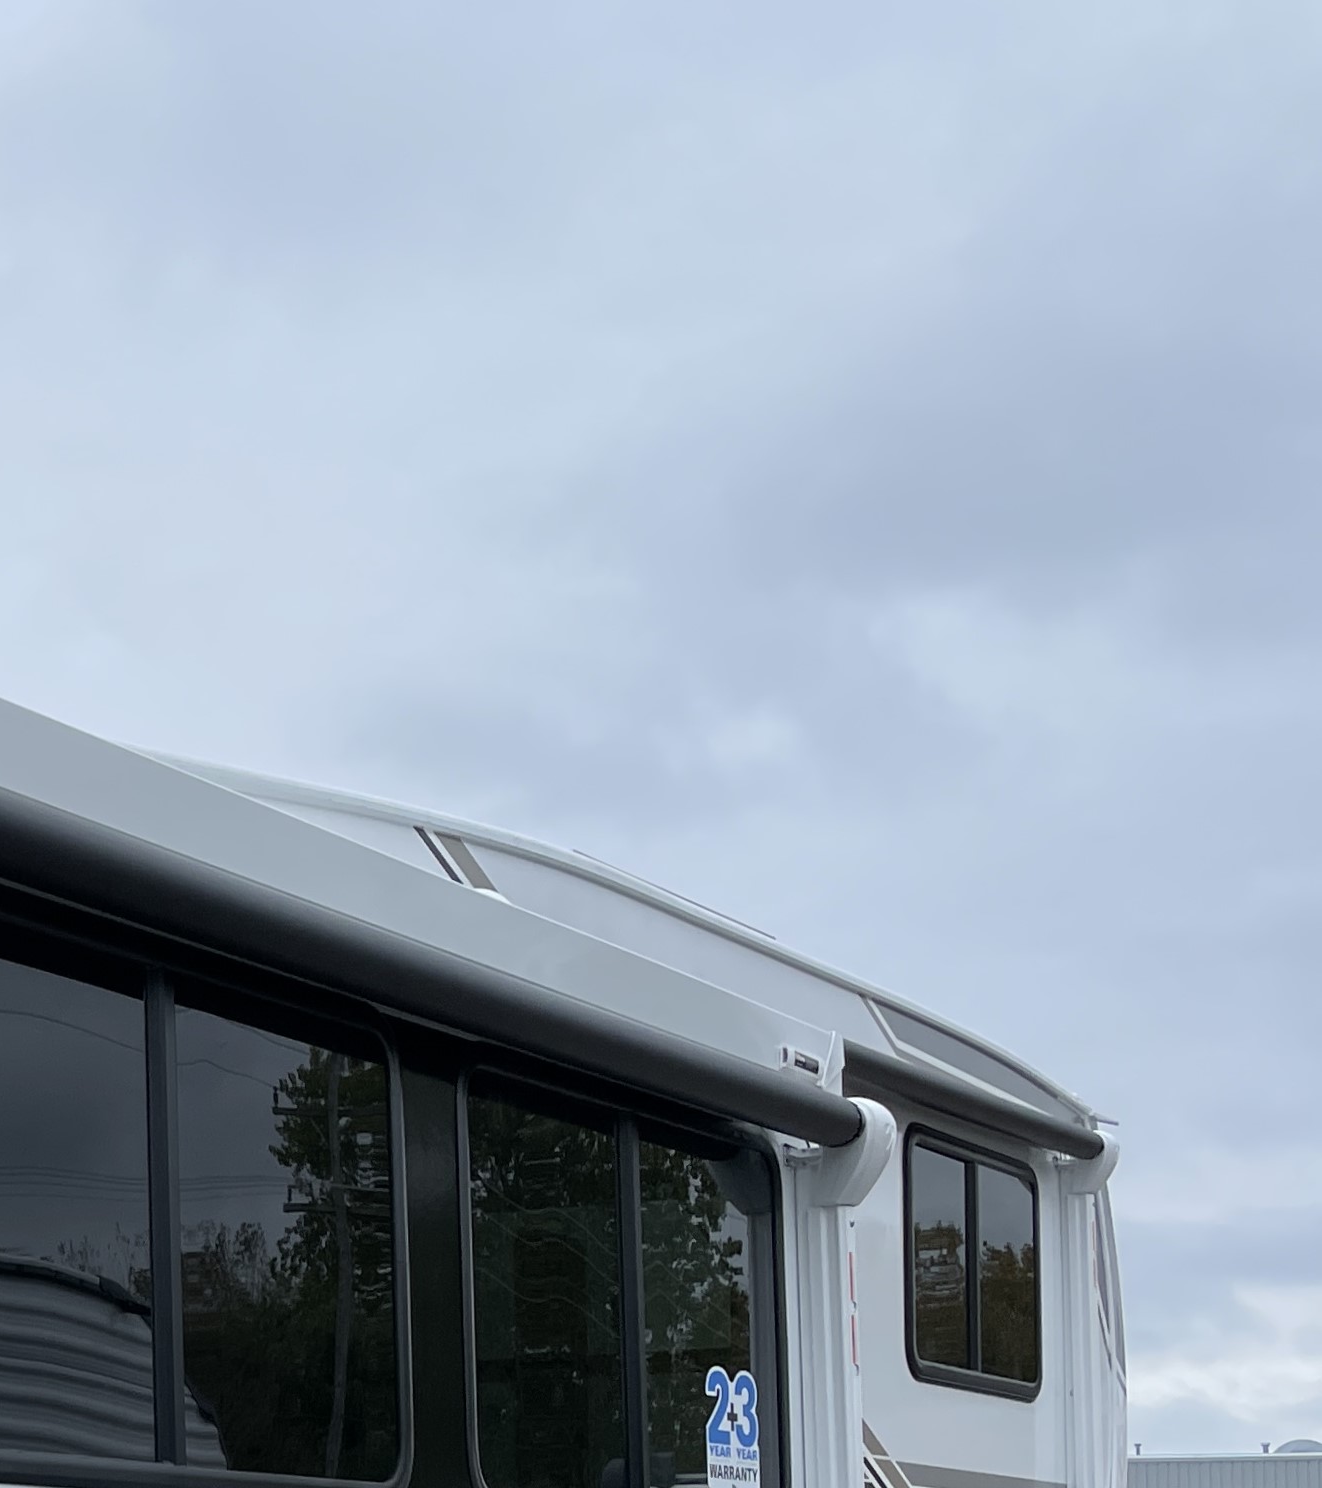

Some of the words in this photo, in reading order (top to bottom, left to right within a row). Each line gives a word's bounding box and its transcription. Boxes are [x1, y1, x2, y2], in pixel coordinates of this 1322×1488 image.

[709, 1445, 732, 1459] YEAR
[736, 1448, 758, 1462] YEAR
[709, 1463, 758, 1483] WARRANTY
